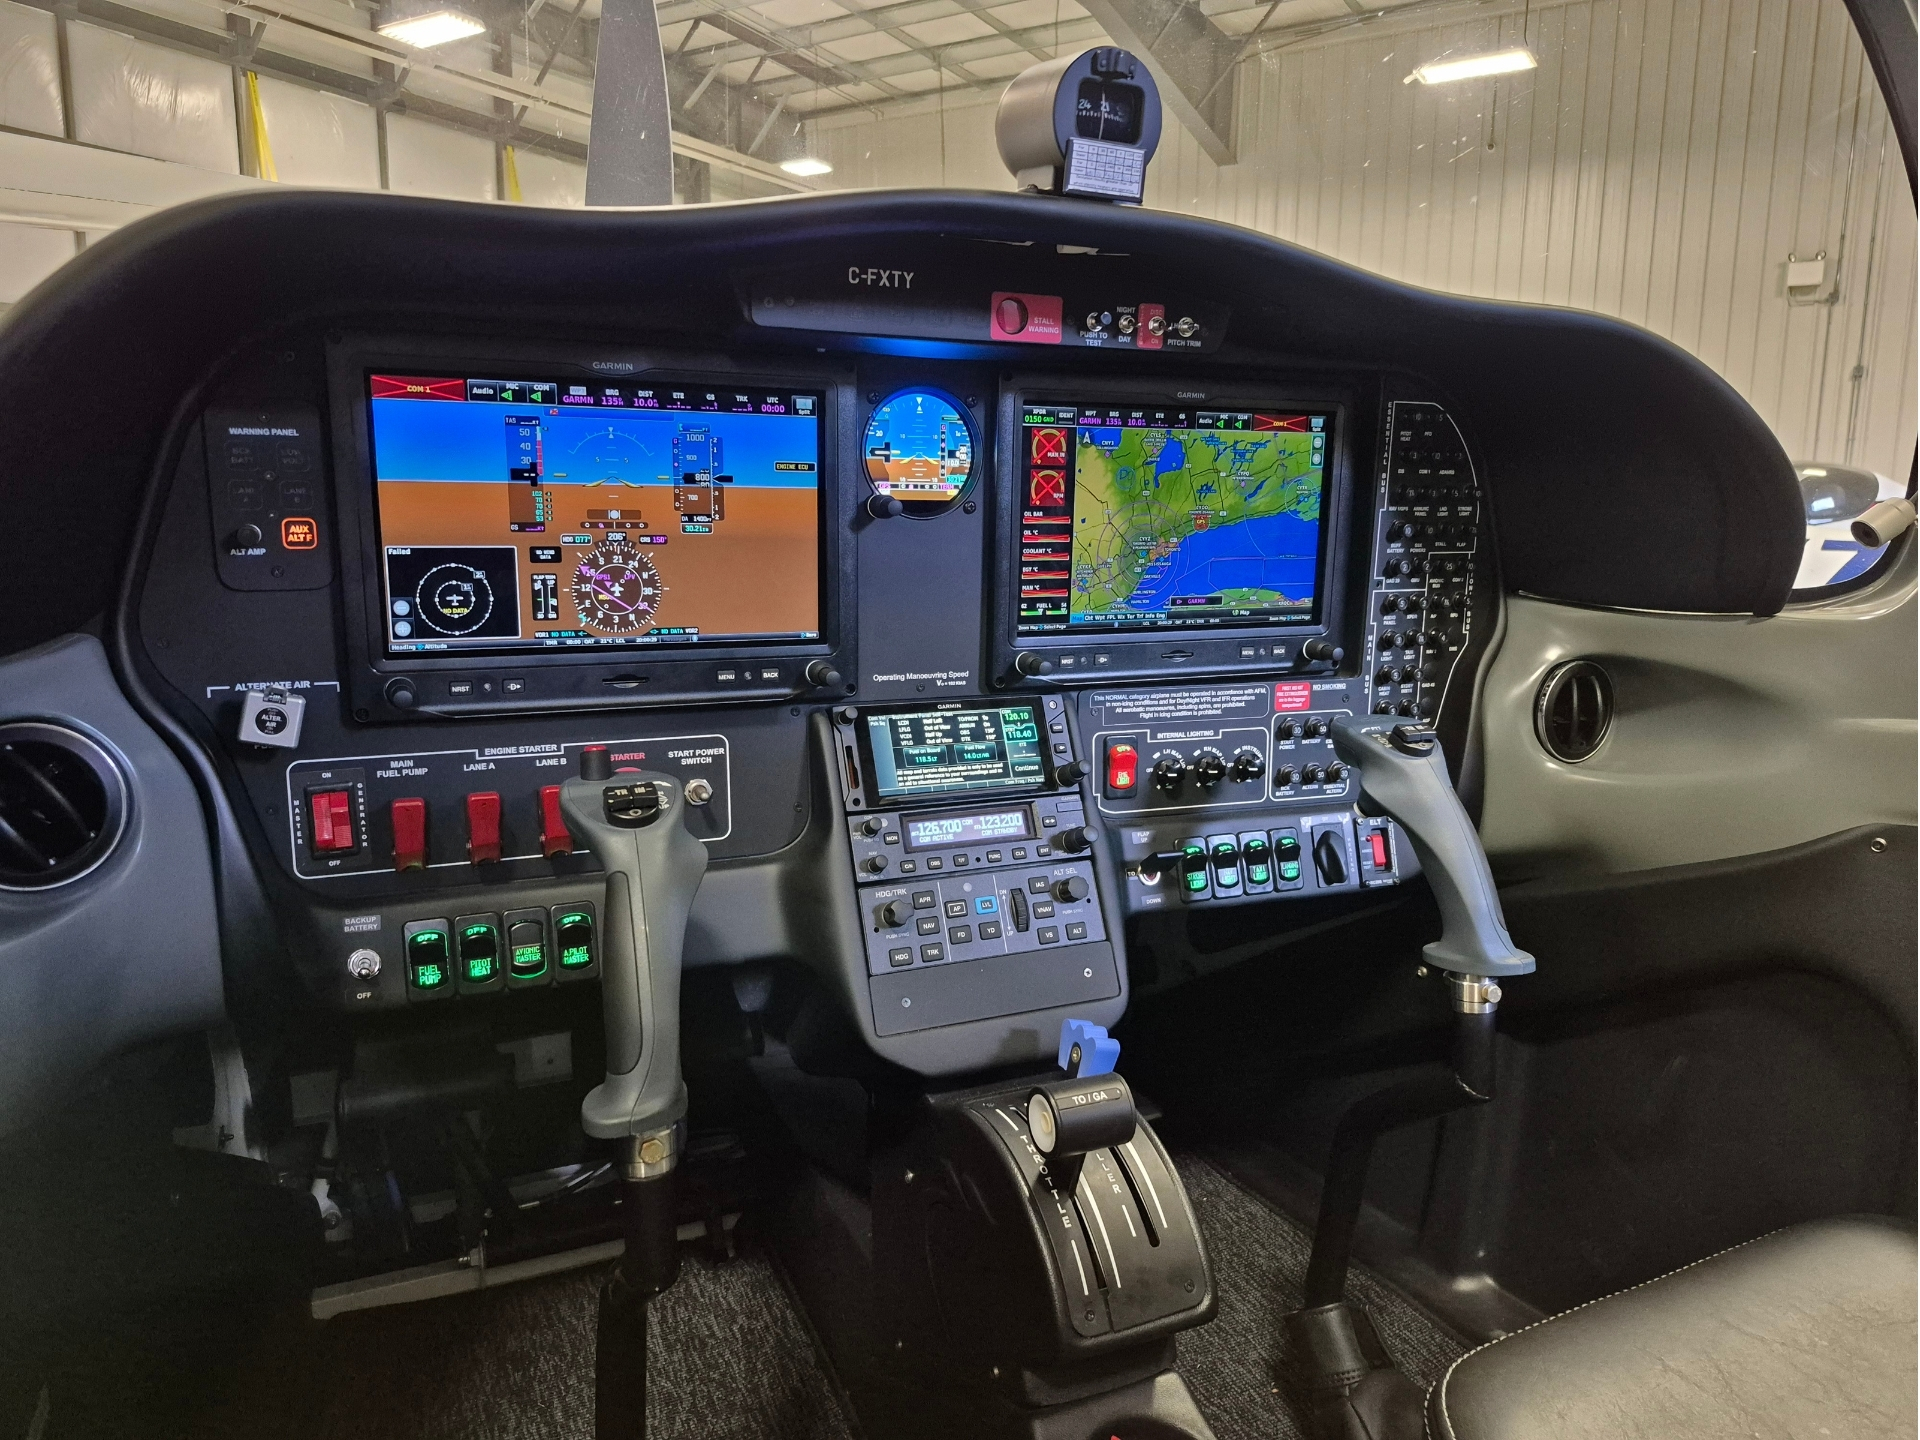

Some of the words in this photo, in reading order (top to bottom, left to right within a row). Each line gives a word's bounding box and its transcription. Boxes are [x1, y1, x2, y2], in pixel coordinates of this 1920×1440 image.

[1078, 98, 1092, 110] 24
[848, 267, 914, 289] C-FXTY
[1034, 317, 1054, 325] STALL
[1028, 326, 1059, 334] WARNING
[592, 362, 633, 370] GARMIN
[472, 387, 494, 395] Audio
[562, 395, 593, 404] GARMN
[761, 404, 785, 413] 00:00
[229, 427, 269, 435] WARNING
[519, 429, 530, 437] 50
[686, 434, 705, 442] 1000
[695, 473, 710, 481] 800
[290, 525, 309, 533] AUX
[288, 534, 304, 542] ALT
[306, 534, 312, 542] F
[628, 561, 638, 569] 24
[873, 672, 905, 682] Operating
[906, 672, 947, 680] Manoeuvring
[949, 671, 969, 679] Speed
[1008, 730, 1031, 738] 118.40
[484, 747, 516, 755] ENGINE
[519, 744, 557, 753] STARTER
[668, 750, 694, 758] START
[696, 748, 725, 756] POWER
[610, 753, 645, 762] STARTER
[681, 757, 712, 765] SWITCH
[390, 760, 413, 768] MAIN
[464, 763, 486, 771] LANE
[536, 759, 557, 767] LANE
[377, 770, 400, 778] FUEL
[402, 768, 428, 776] PUMP
[357, 783, 368, 847] GENERATOR
[293, 800, 303, 844] MASTER
[979, 814, 1023, 830] 123.200
[917, 820, 962, 836] 126.700
[1187, 873, 1205, 881] STROBE
[1252, 872, 1267, 881] LIGHT
[1284, 869, 1298, 878] LIGHT
[1222, 874, 1237, 883] LIGHT
[1190, 880, 1204, 888] LIGHT
[876, 888, 907, 898] HDG/TRK
[344, 916, 377, 925] BACKUP
[564, 916, 581, 924] OFF
[344, 923, 378, 932] BATTERY
[466, 927, 487, 936] OFF
[418, 934, 439, 942] OFF
[516, 946, 540, 956] AVIONIC
[563, 946, 587, 957] A.PILOT
[516, 953, 540, 963] MASTER
[563, 953, 589, 964] MASTER
[470, 958, 491, 968] PITOT
[419, 966, 440, 976] FUEL
[471, 966, 491, 976] HEAT
[420, 975, 441, 985] PUMP
[1072, 1095, 1085, 1105] TO
[1092, 1091, 1108, 1100] GA
